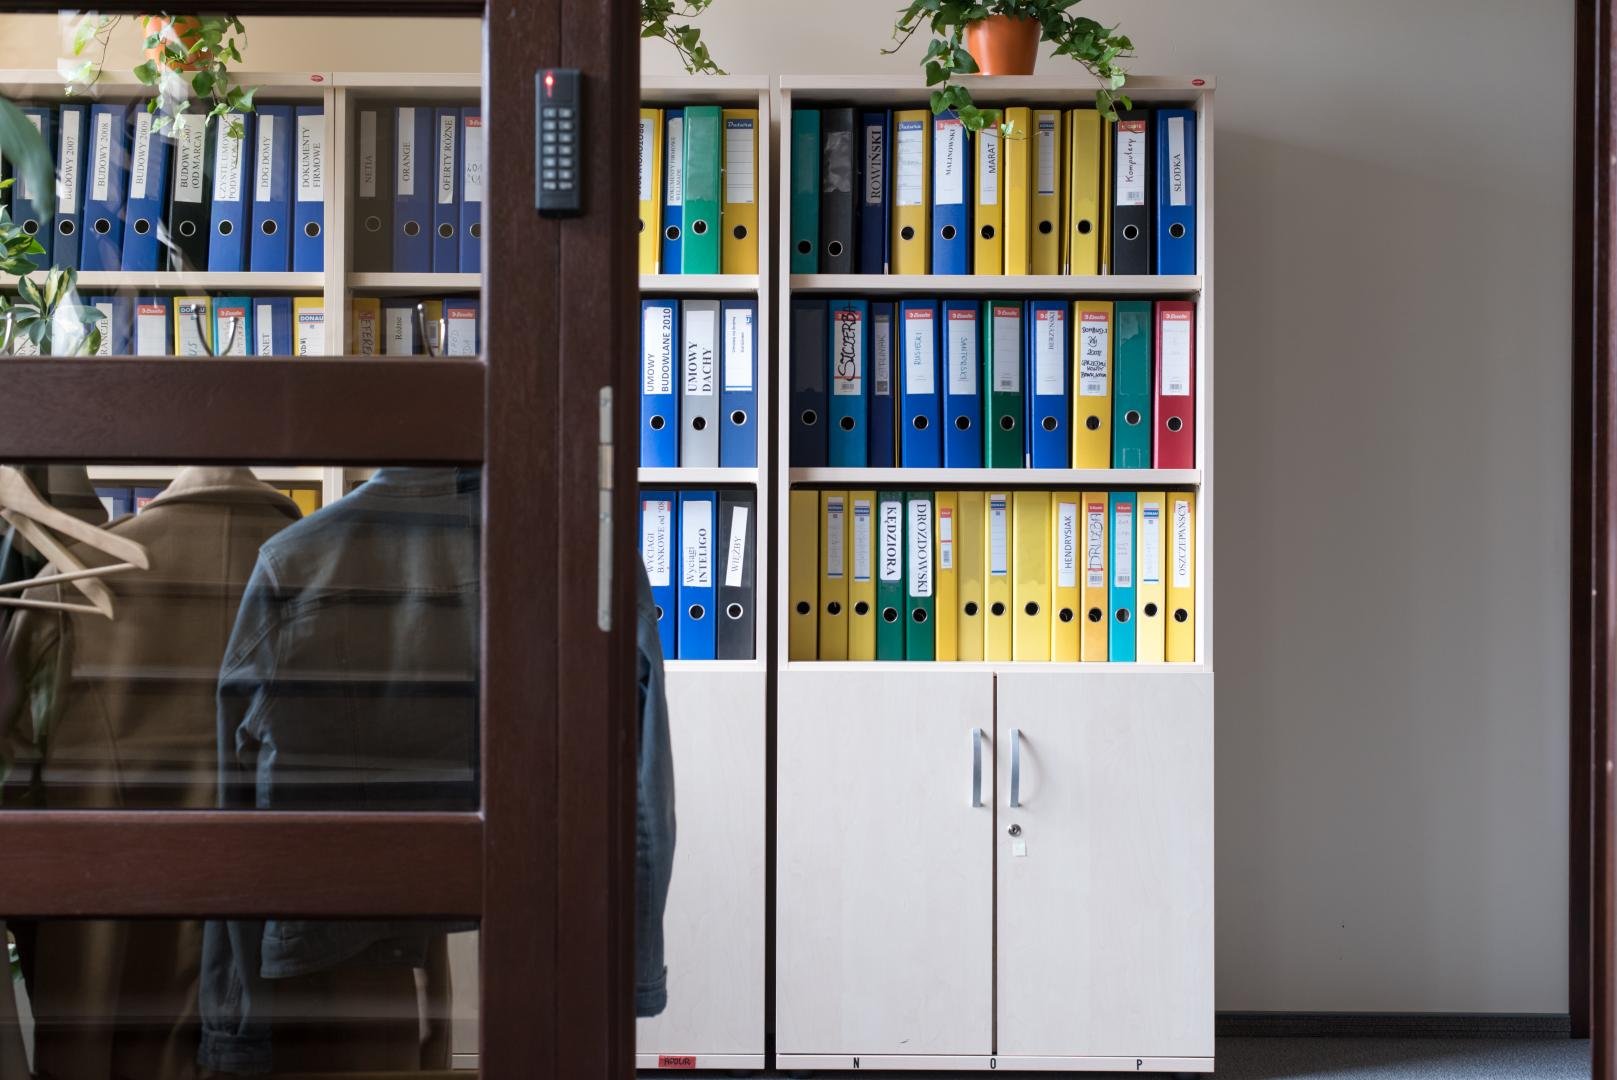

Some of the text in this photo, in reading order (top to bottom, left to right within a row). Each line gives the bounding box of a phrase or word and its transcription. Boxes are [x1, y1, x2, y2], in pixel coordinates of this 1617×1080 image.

[66, 135, 75, 156] 2007
[97, 122, 109, 187] BUDOWY 2008
[135, 142, 147, 185] BUDOWY
[180, 145, 190, 188] BUDOWY
[191, 131, 202, 189] (OD MARCA)
[261, 136, 271, 188] DDG DOMY
[302, 127, 311, 188] DOKUMENTY
[312, 142, 321, 188] FIRMOWE
[402, 141, 411, 182] ORANGE
[442, 119, 453, 191] OFERTY RÓŻNE
[867, 130, 882, 199] ROWIŃSKI
[945, 128, 956, 176] MALINOWSKI
[987, 142, 997, 174] MARAT
[1123, 138, 1137, 183] Komputery
[365, 155, 373, 184] NETIA
[646, 353, 655, 392] UMOWY
[661, 308, 672, 392] BUDOWLANE 2010
[687, 341, 698, 392] UMOWY
[702, 347, 712, 392] DACHY
[657, 515, 665, 526] od
[884, 506, 897, 576] KĘDZIORA
[1063, 515, 1073, 569] HENDRYSIAK
[657, 527, 665, 574] BANKOWE
[698, 527, 708, 583] INTELIGO
[916, 503, 928, 593] DROZDOWSKI
[853, 1058, 861, 1069] N
[1136, 1058, 1143, 1069] P
